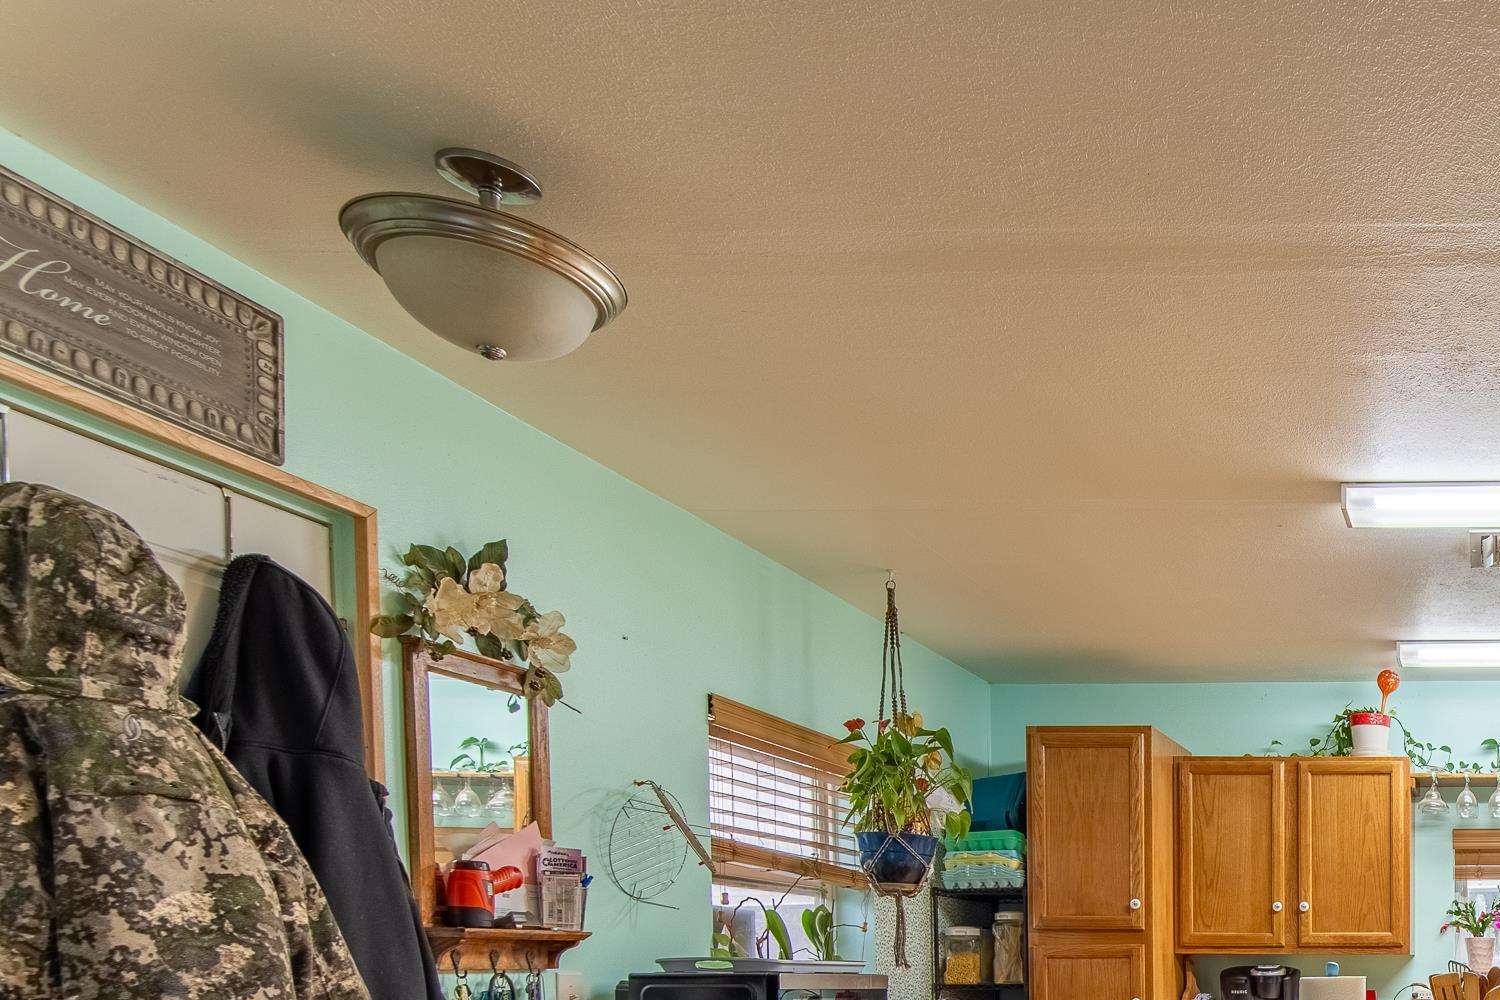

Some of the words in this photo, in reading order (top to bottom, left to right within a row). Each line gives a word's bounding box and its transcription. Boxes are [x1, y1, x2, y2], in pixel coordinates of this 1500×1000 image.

[0, 234, 112, 328] Home
[64, 275, 84, 289] MAY
[86, 286, 117, 305] EVERY
[119, 302, 147, 320] ROOM
[148, 317, 174, 333] HOLD
[94, 278, 115, 293] MAY
[118, 291, 144, 306] YOUR
[145, 305, 174, 323] WALLS
[175, 320, 201, 337] KNOW
[109, 309, 128, 322] AND
[129, 319, 158, 335] EVERY
[160, 334, 197, 356] WINDOW
[198, 352, 223, 367] OPEN
[126, 327, 138, 338] TO
[140, 335, 169, 352] GREAT
